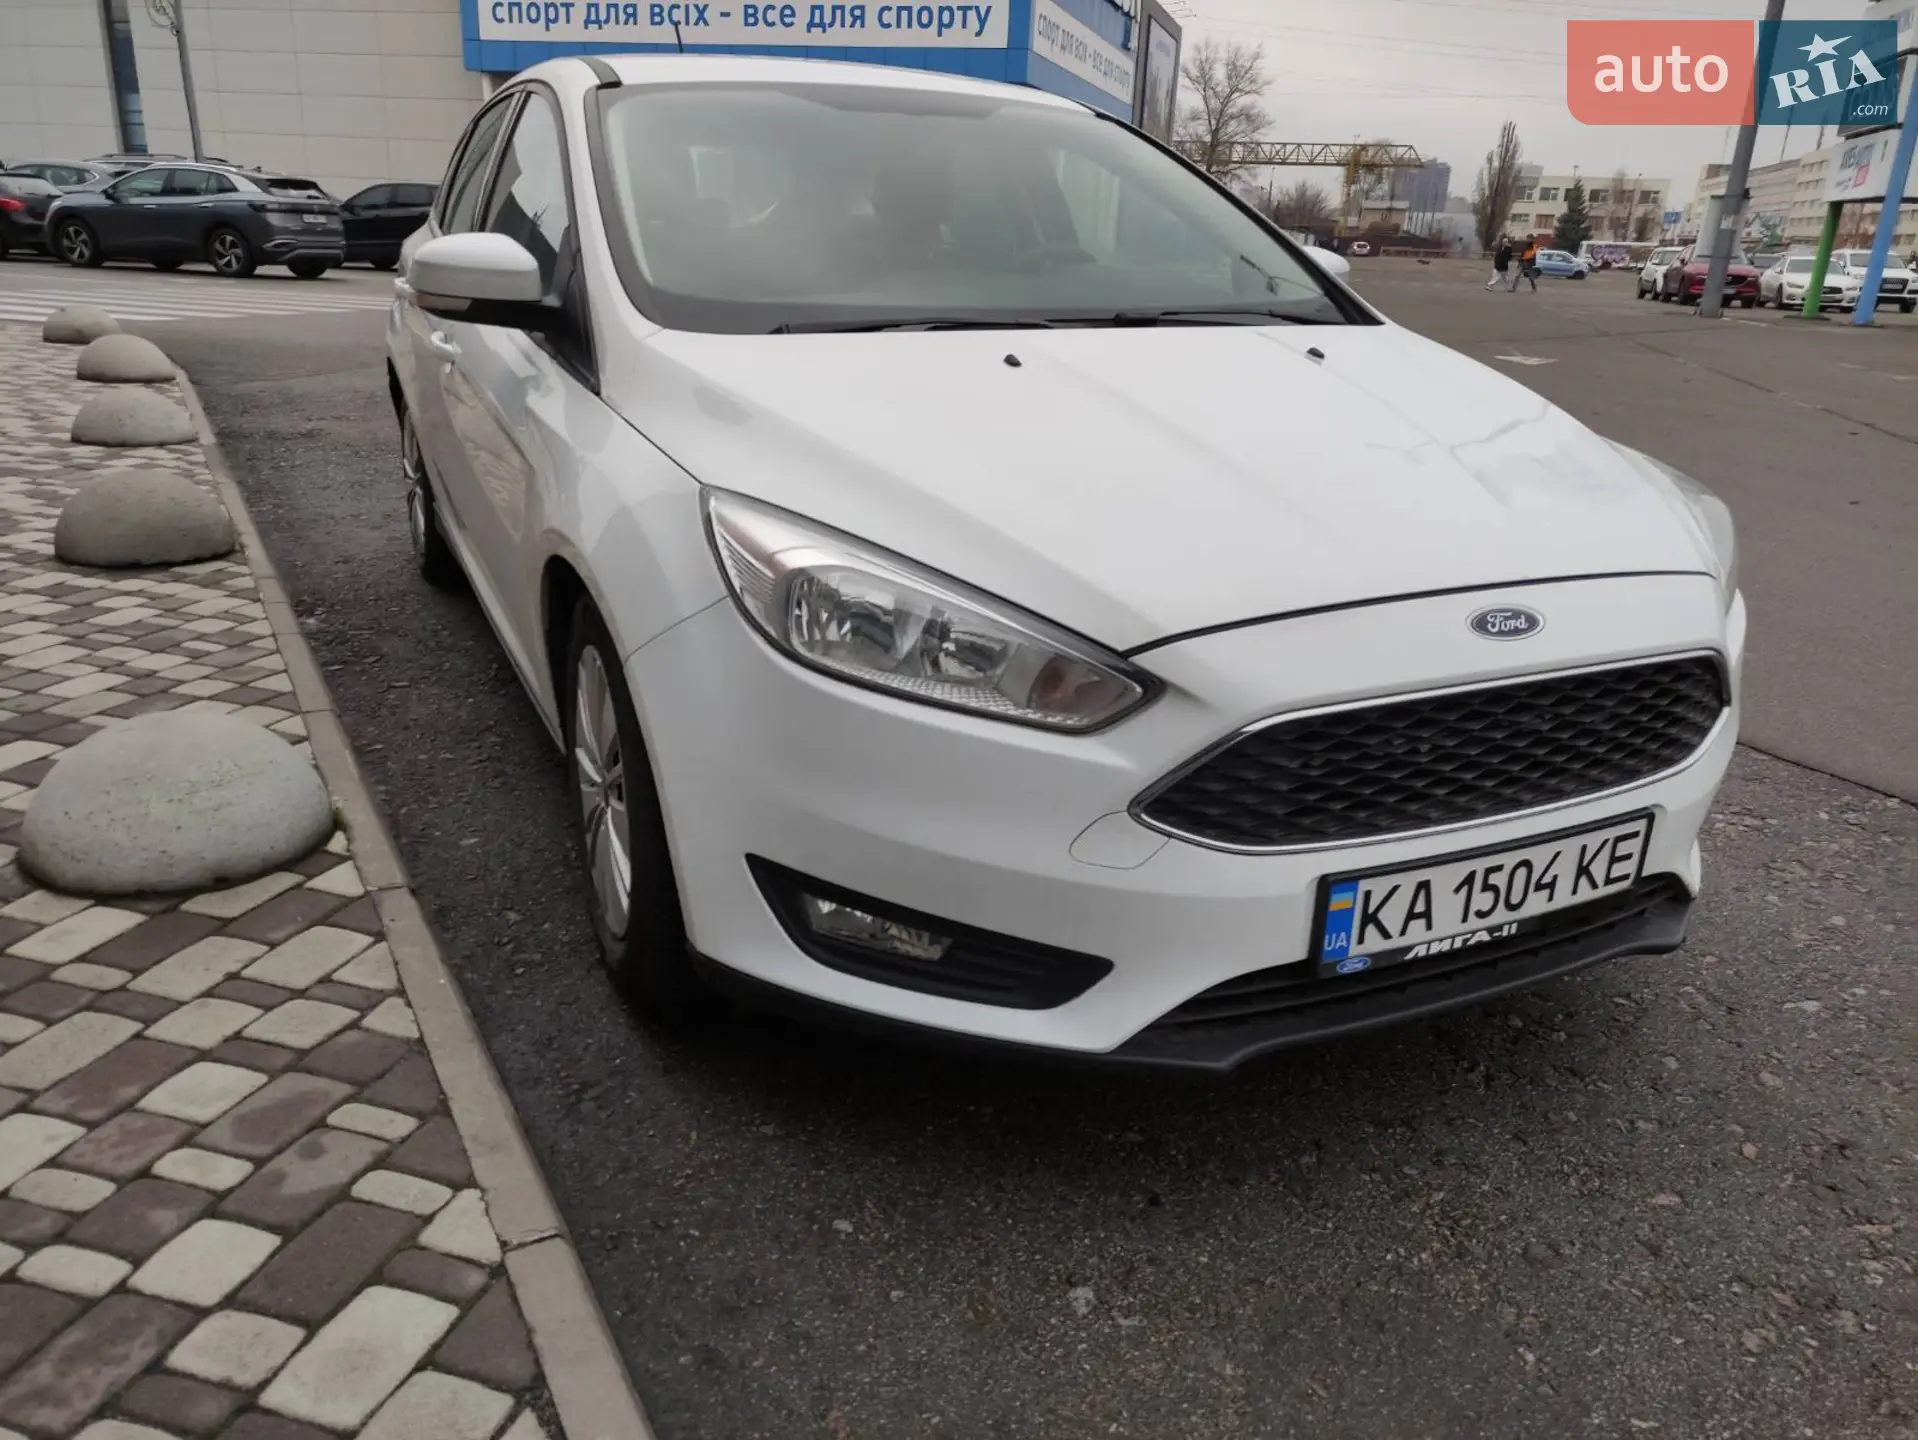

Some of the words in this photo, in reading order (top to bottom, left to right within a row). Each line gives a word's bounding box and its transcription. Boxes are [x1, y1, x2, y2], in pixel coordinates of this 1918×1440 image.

[492, 2, 575, 31] спорт
[584, 2, 638, 30] для
[743, 4, 797, 28] все
[806, 4, 866, 33] для
[877, 4, 992, 37] спорту
[1486, 611, 1529, 633] Ford
[1356, 879, 1434, 946] KA
[1453, 850, 1562, 924] 1504
[1571, 830, 1641, 897] KE
[1324, 931, 1348, 950] UA
